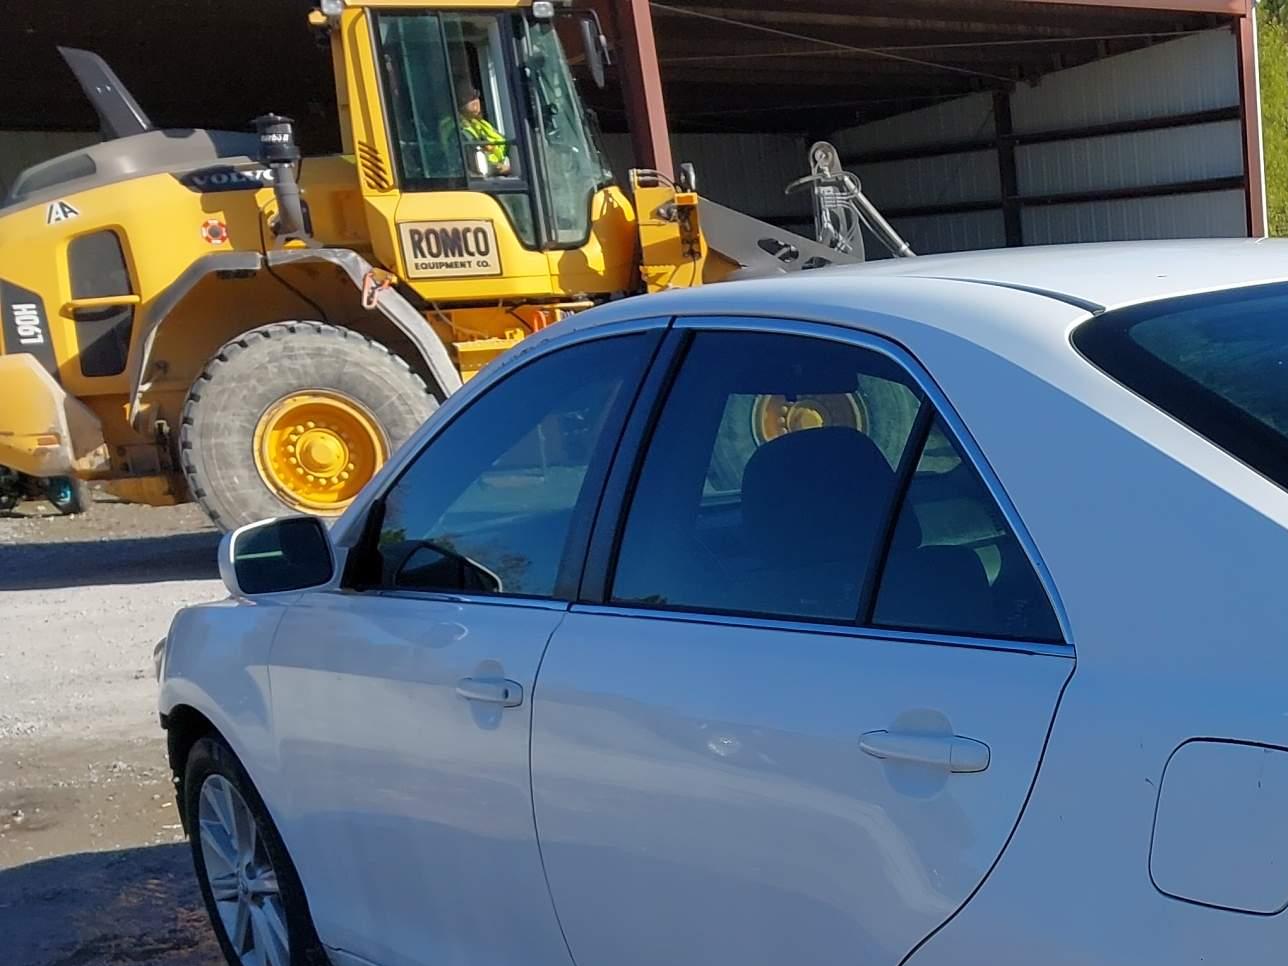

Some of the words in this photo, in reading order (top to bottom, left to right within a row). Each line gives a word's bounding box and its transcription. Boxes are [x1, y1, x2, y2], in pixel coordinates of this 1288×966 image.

[409, 226, 490, 259] ROMCO
[414, 260, 473, 271] EQUIPMENT
[476, 260, 491, 268] CO.
[11, 303, 44, 345] L90H
